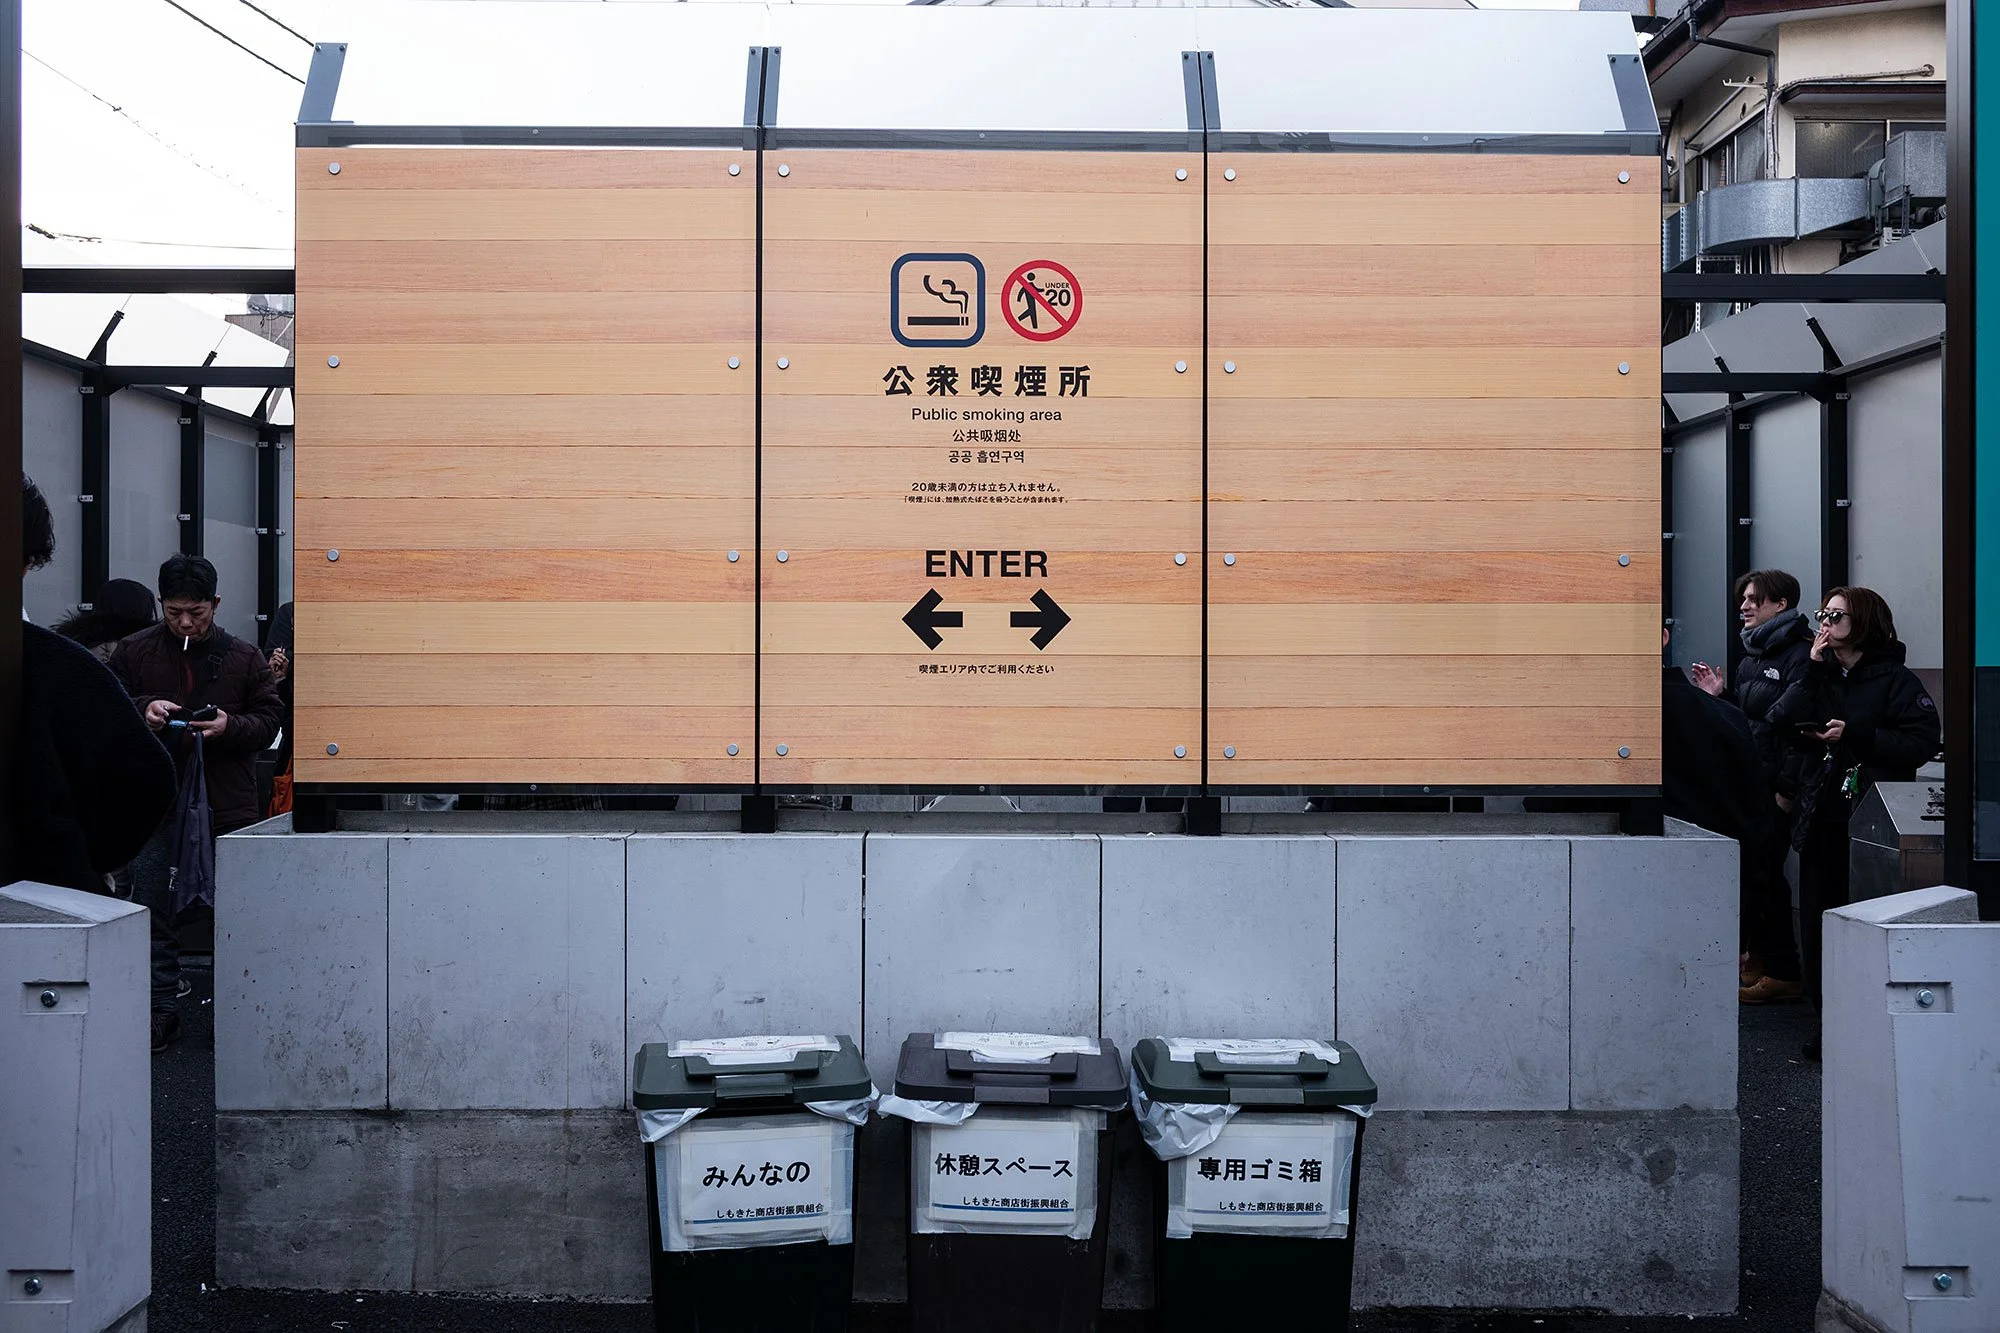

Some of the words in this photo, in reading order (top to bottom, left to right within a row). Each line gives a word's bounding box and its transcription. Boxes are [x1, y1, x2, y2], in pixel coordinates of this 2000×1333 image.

[1046, 289, 1071, 307] 20
[882, 365, 1091, 398] 公衆喫煙所
[911, 408, 957, 421] Public
[962, 408, 1025, 424] smoking
[1029, 410, 1063, 421] area
[952, 429, 1022, 443] 公共吸烟处
[948, 450, 972, 463] 공공
[977, 450, 1025, 463] 흡연구역
[911, 482, 1061, 493] 20歳未満の方は立ち入れません。
[925, 550, 1048, 578] ENTER
[919, 664, 1055, 675] 喫煙エリア内でご利用ください
[934, 1153, 1074, 1178] 休憩スペース
[1197, 1157, 1323, 1183] 専用ゴミ箱
[702, 1161, 811, 1189] みんなの
[962, 1196, 1070, 1209] しもきた商店街振興組合
[1218, 1201, 1324, 1213] しもきた商店街振興組合
[716, 1203, 825, 1219] しもきた商店街振興組合
